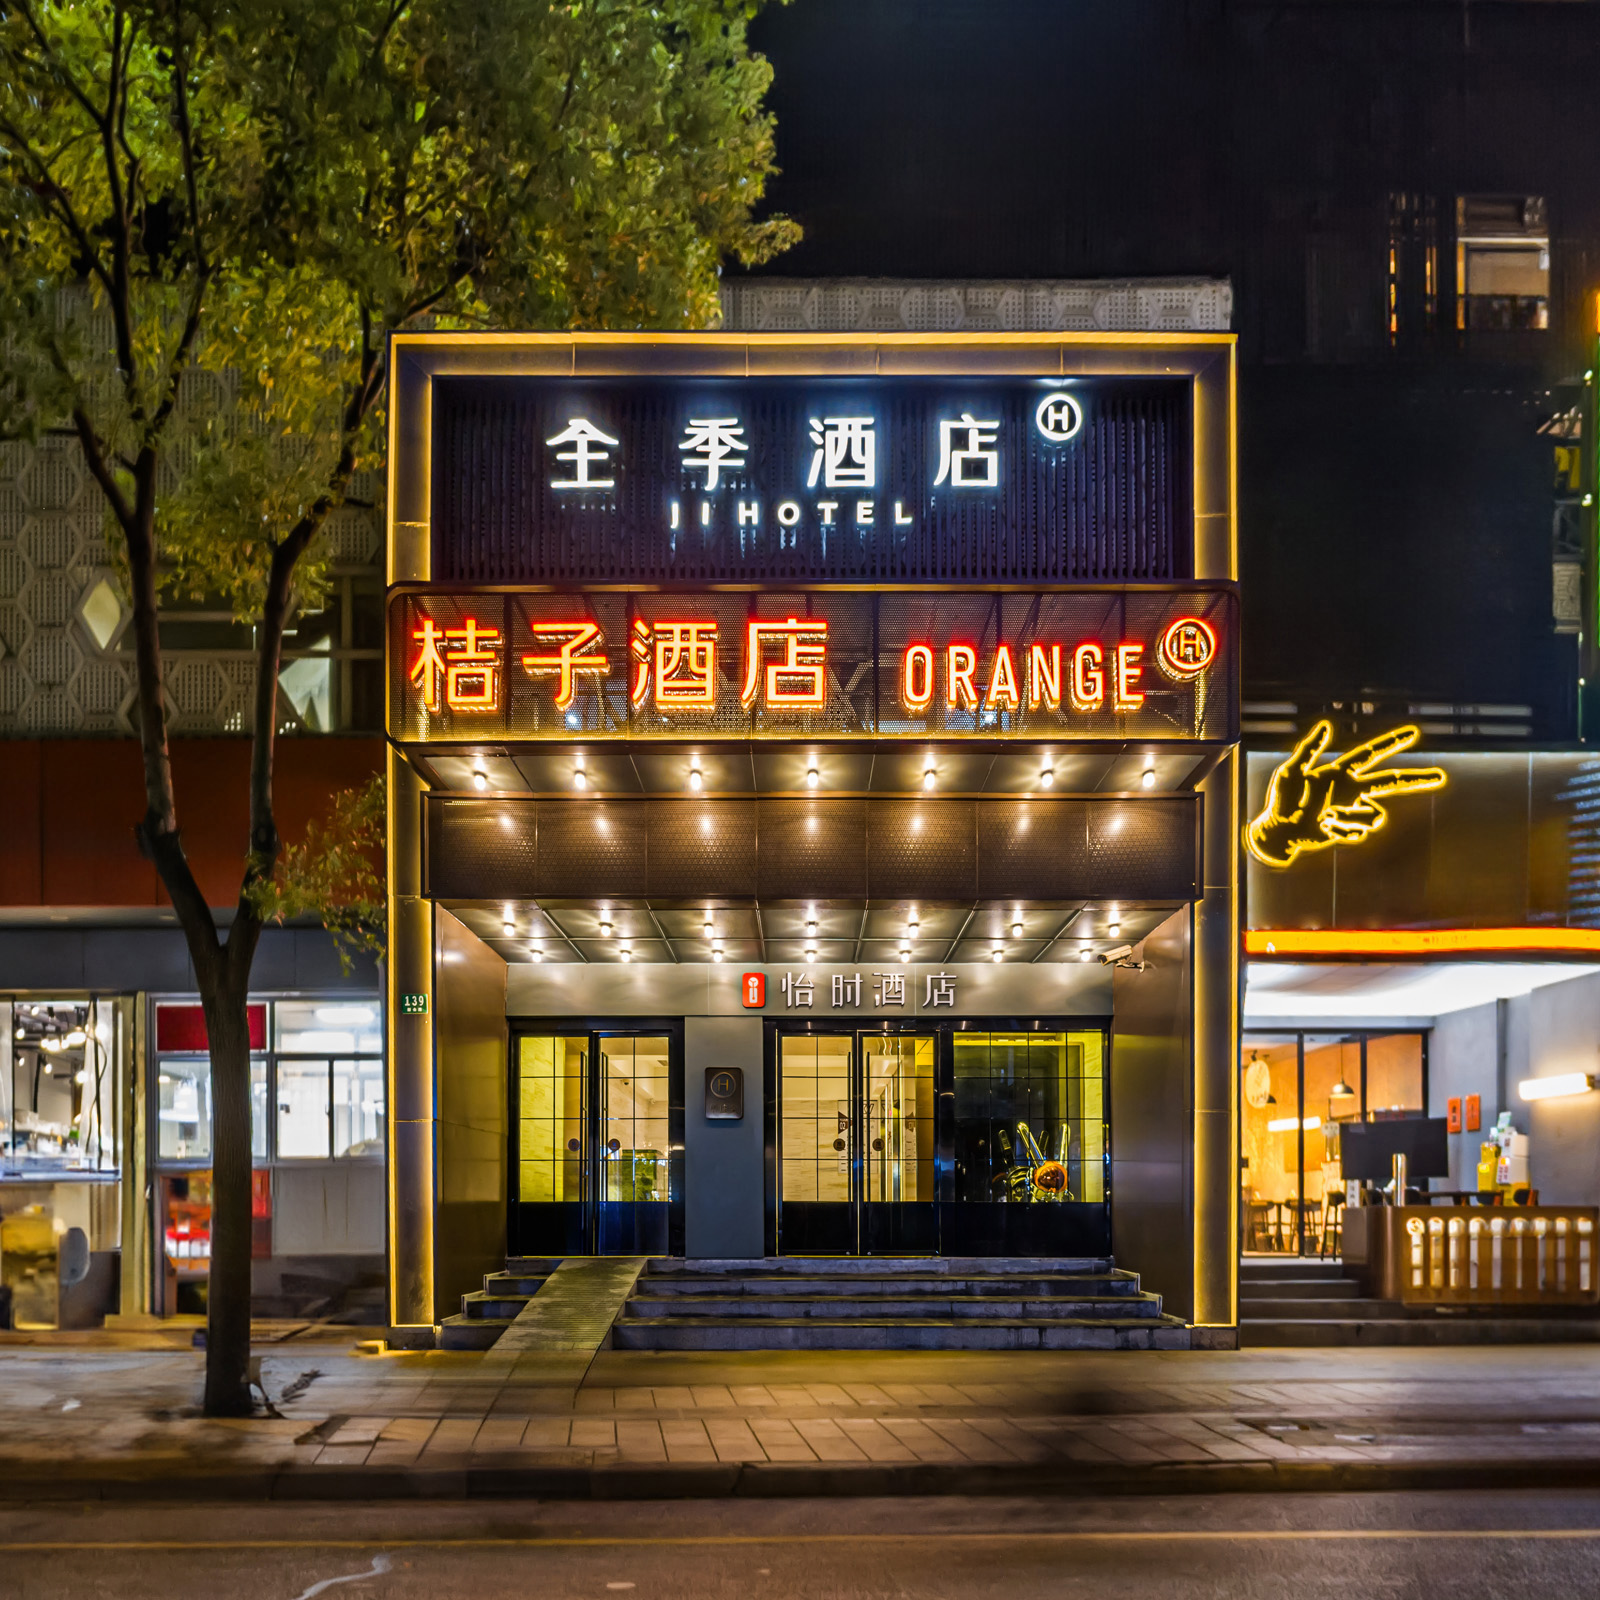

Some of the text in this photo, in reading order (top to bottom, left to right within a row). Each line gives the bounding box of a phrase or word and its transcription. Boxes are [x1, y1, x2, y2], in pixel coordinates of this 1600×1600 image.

[546, 413, 1000, 492] 全季酒店
[670, 502, 913, 529] JI HOTEL
[410, 617, 829, 711] 桔子酒店
[903, 643, 1146, 711] ORANGE
[404, 995, 425, 1007] 139
[781, 971, 958, 1008] 怡时酒店
